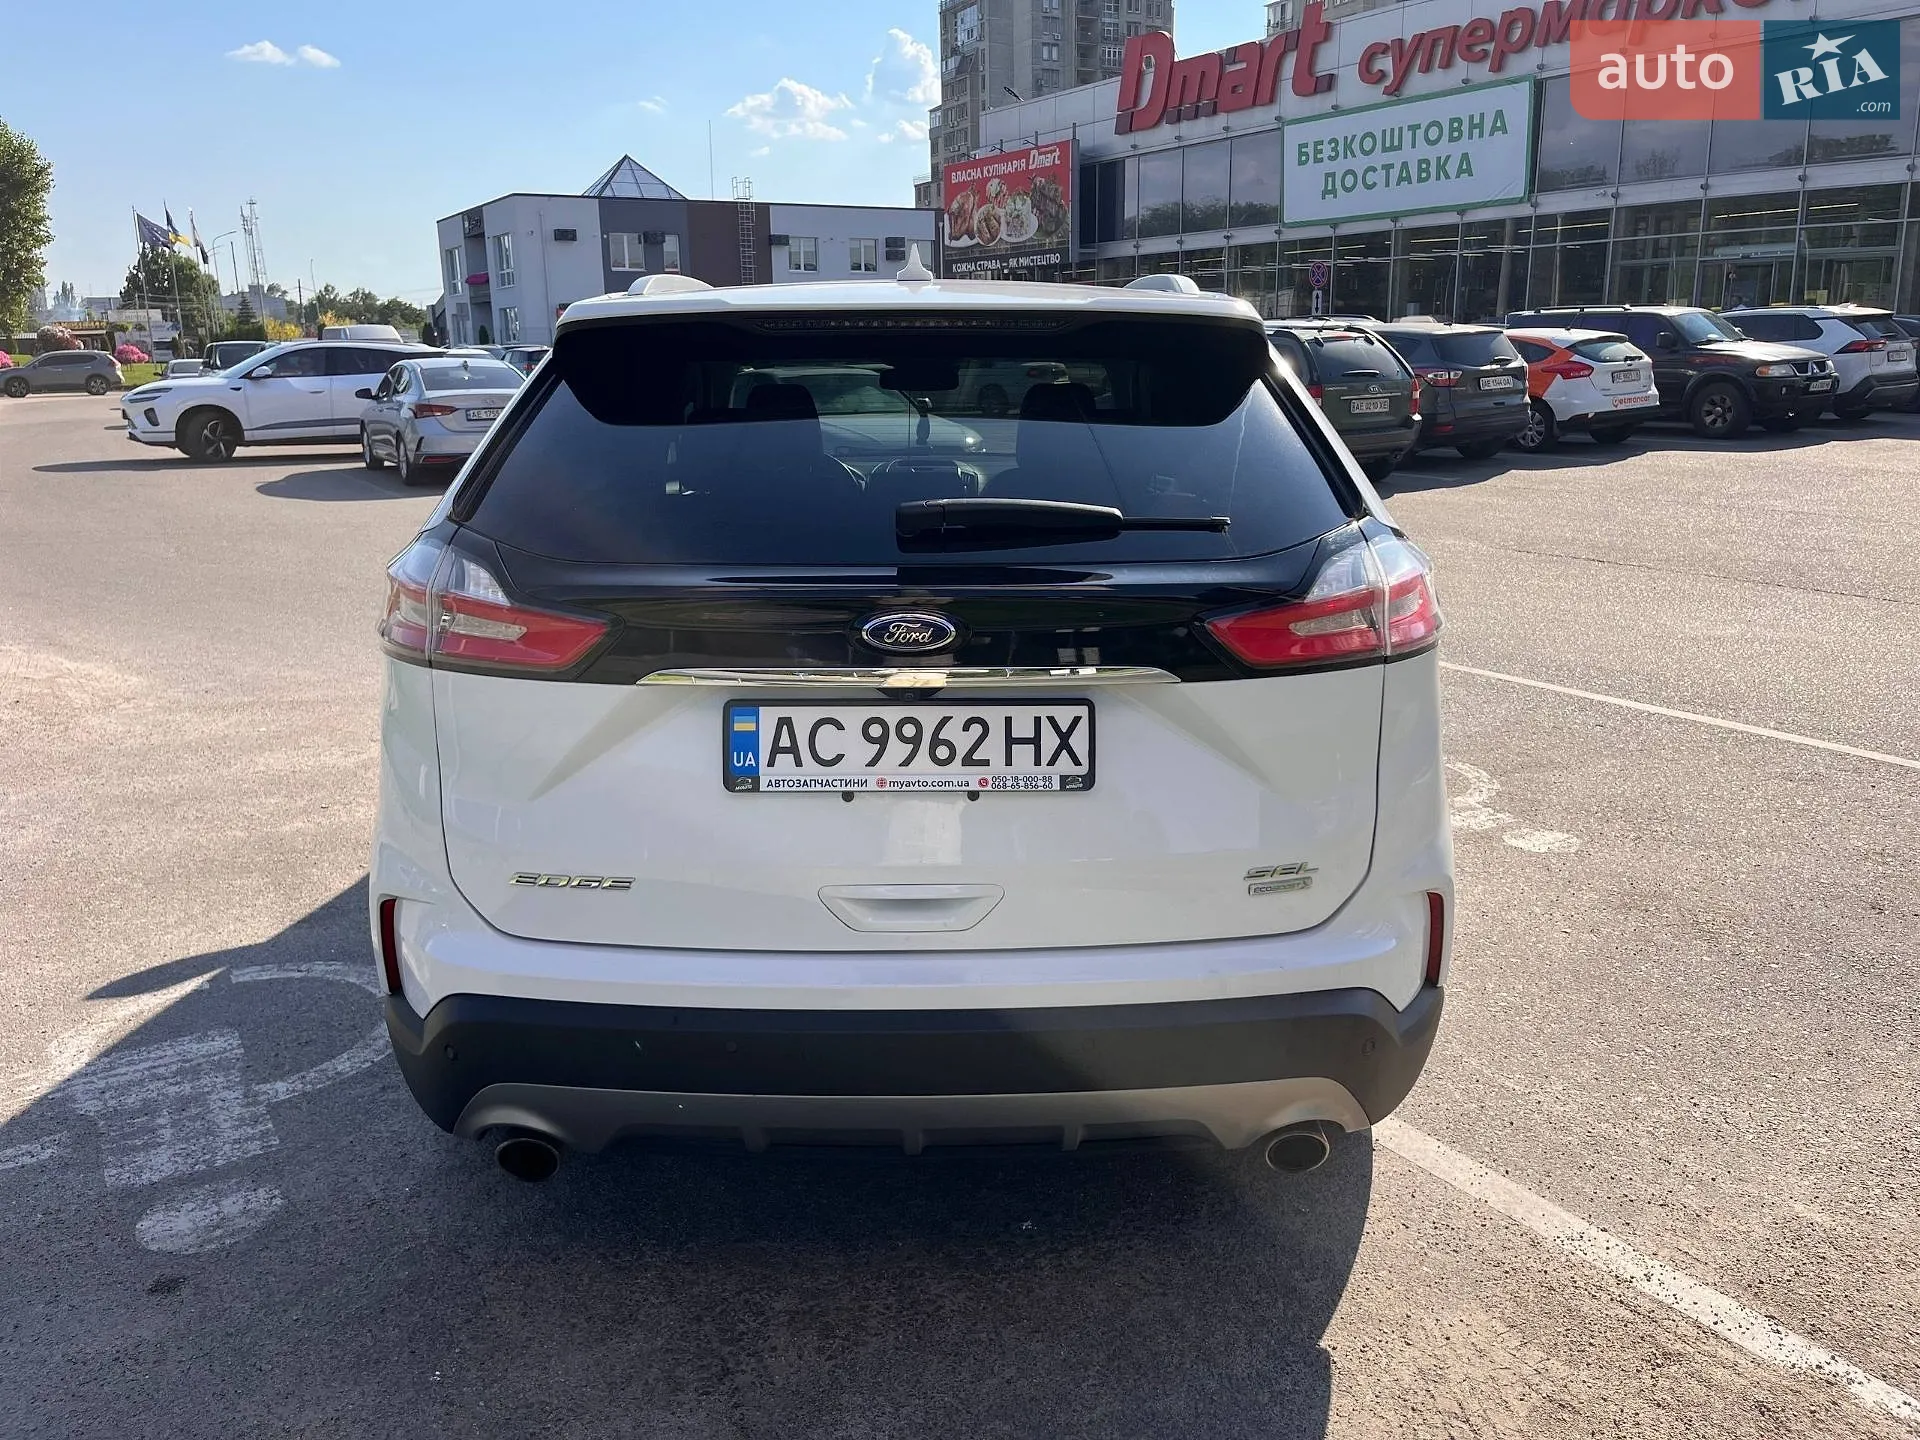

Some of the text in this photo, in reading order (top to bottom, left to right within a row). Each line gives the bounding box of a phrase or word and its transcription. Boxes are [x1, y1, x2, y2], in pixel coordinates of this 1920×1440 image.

[1356, 0, 1769, 96] супермар
[1114, 1, 1335, 135] Dmart
[1297, 109, 1508, 166] БЕЗКОШТОВНА
[951, 167, 982, 184] ВЛАСНА
[983, 159, 1026, 178] КУЛІНАРІЯ
[1029, 147, 1061, 170] Dmart
[1321, 152, 1474, 200] ДОСТАВКА
[952, 262, 976, 273] КОЖНА
[976, 259, 1001, 272] СТРАВА
[1008, 258, 1018, 269] ЯК
[1019, 253, 1061, 267] МИСТЕЦТВО
[883, 622, 934, 643] Ford
[766, 715, 1083, 768] AC 9962 HX
[733, 751, 756, 767] UA
[766, 778, 868, 789] АВТОЗАПЧАСТИНИ
[888, 778, 970, 790] myavto.com.ua
[991, 782, 1053, 790] 068-65-856-60
[509, 872, 636, 890] EDGE
[1243, 862, 1319, 881] SEL
